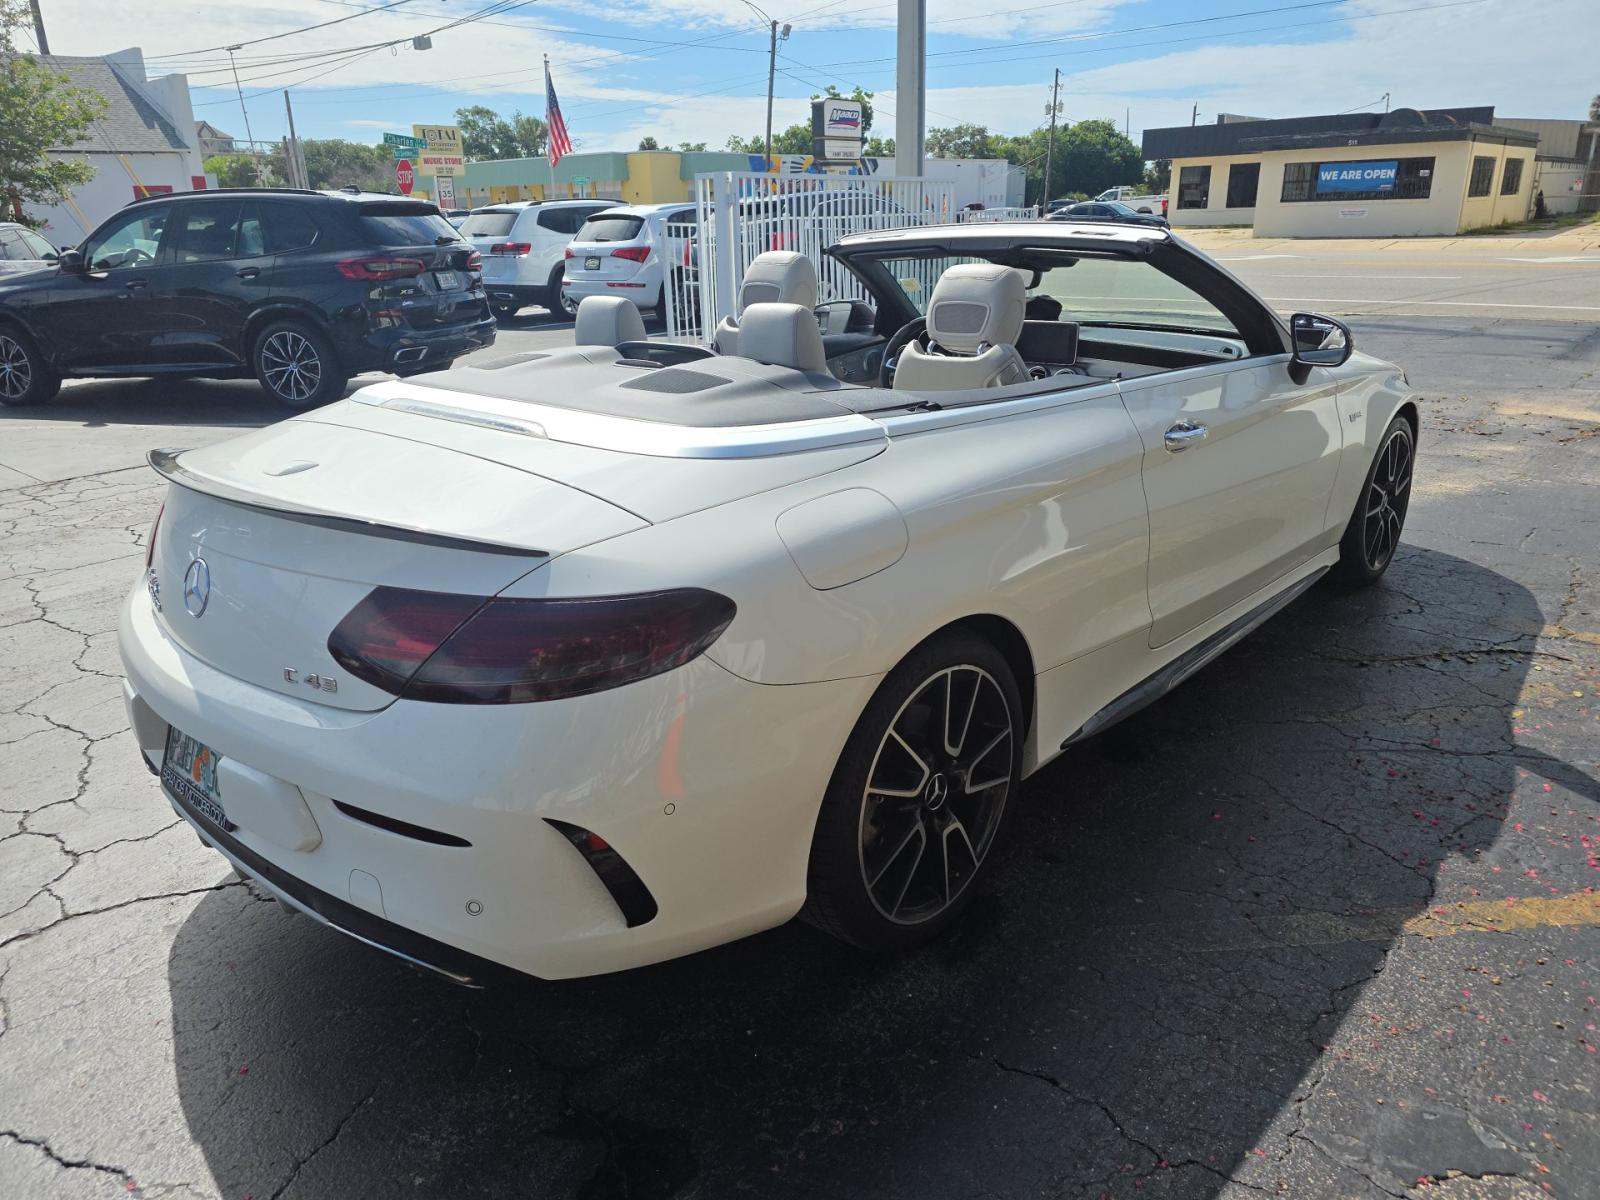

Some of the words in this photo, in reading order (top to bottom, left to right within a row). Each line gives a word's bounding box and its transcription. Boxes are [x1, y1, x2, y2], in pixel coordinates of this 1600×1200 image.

[831, 109, 859, 121] Maaco
[423, 157, 443, 165] MUSIC
[444, 157, 463, 165] STORE
[397, 170, 413, 184] STOP
[1321, 170, 1339, 181] WE
[1340, 169, 1362, 180] ARE
[1363, 168, 1395, 179] OPEN
[442, 190, 453, 198] 35
[283, 666, 298, 684] C
[303, 672, 338, 694] 43
